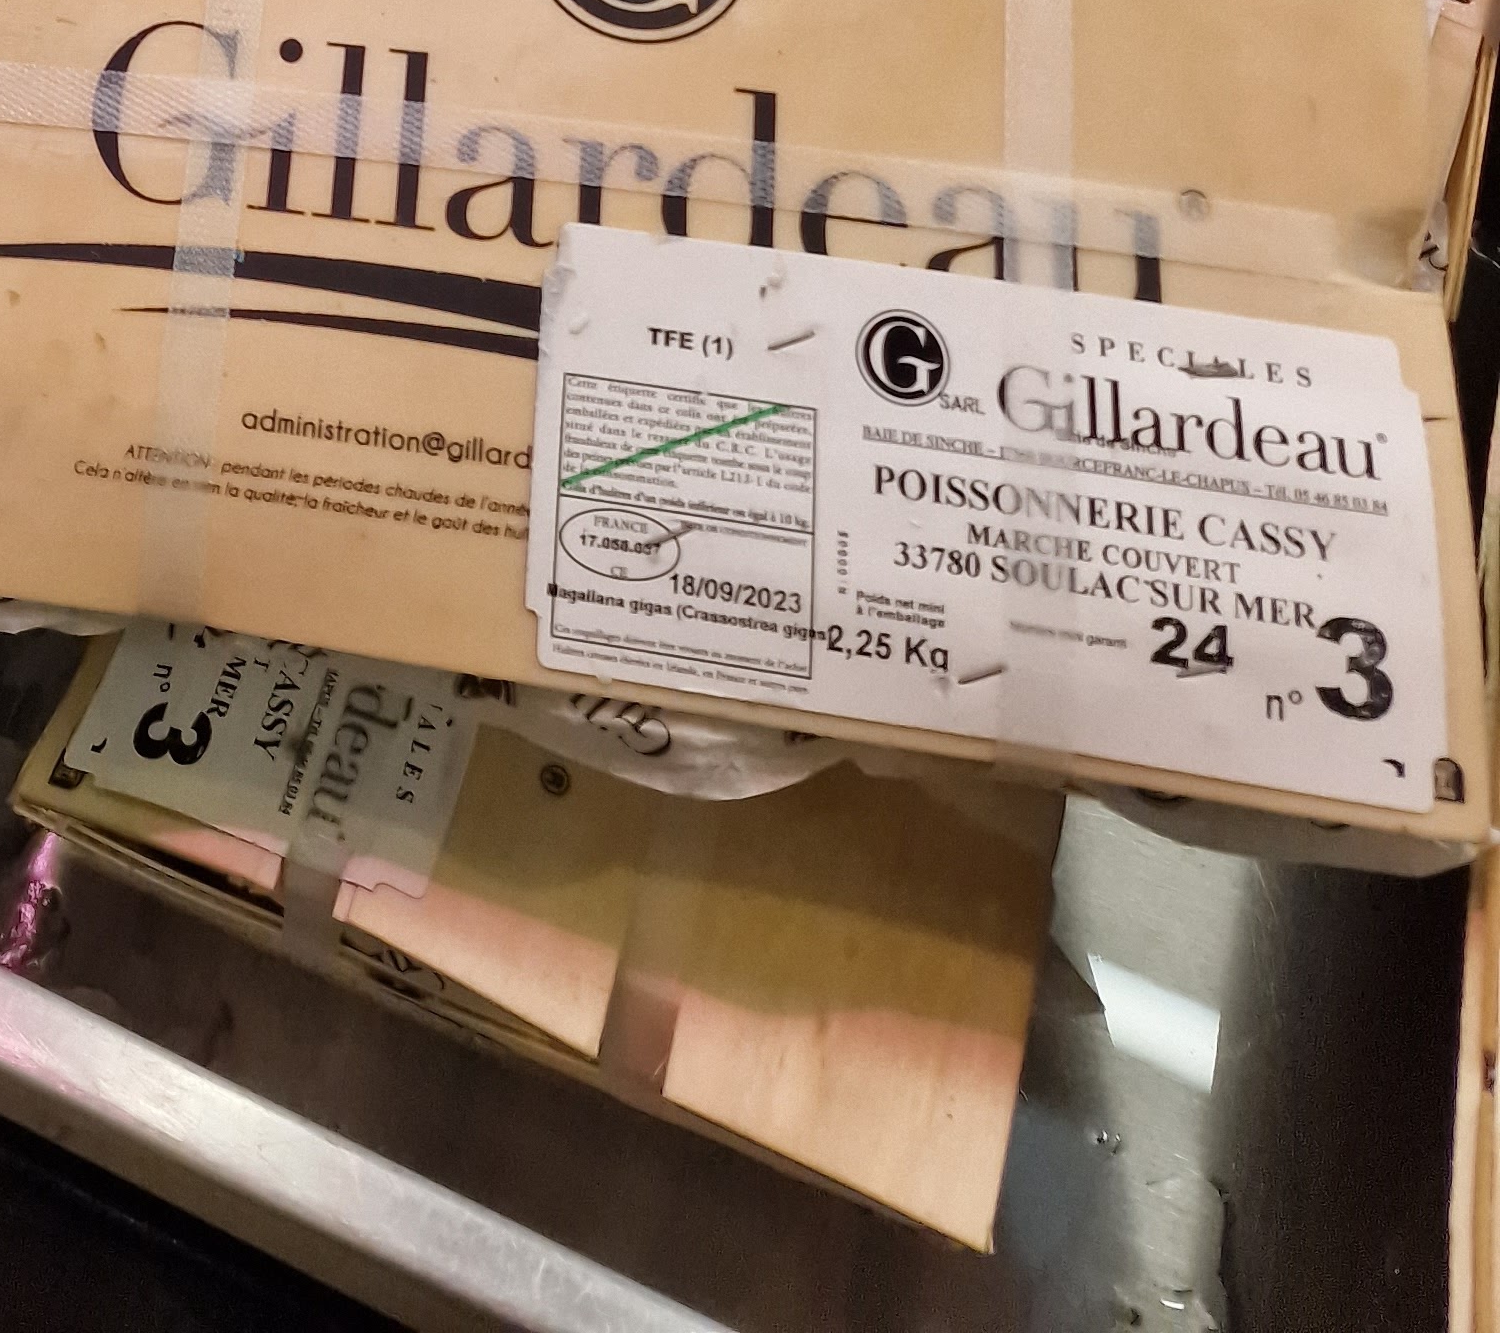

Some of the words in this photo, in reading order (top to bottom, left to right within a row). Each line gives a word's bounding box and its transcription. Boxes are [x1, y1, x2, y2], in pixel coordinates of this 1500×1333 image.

[647, 325, 694, 351] TFE
[702, 333, 734, 360] (1)
[938, 394, 987, 416] SARL
[997, 364, 1384, 481] Gillardeau
[899, 429, 921, 446] DE
[73, 459, 110, 479] Cela
[225, 482, 239, 498] la
[303, 494, 318, 510] la
[322, 496, 389, 520] fraîcheur
[392, 507, 411, 523] et
[412, 510, 428, 526] le
[431, 511, 468, 531] goût
[471, 518, 500, 538] des
[220, 459, 285, 482] pendant
[288, 468, 309, 484] les
[312, 472, 381, 496] périodes
[385, 482, 450, 506] chaudes
[455, 493, 475, 510] de
[593, 515, 649, 535] FRANCE
[873, 464, 1184, 541] POISSONNERIE
[1197, 514, 1337, 563] CASSY
[967, 523, 1093, 563] MARCHE
[1102, 545, 1240, 585] COUVERT
[669, 572, 803, 615] 18/09/2023
[893, 541, 982, 580] 33780
[990, 553, 1143, 605] SOULAC
[1149, 579, 1222, 617] SUR
[1235, 593, 1318, 631] MER
[895, 598, 914, 609] net
[629, 597, 672, 617] gigas
[676, 602, 778, 633] (Crassostrea
[826, 624, 893, 660] 2,25
[1150, 616, 1234, 668] 24
[206, 656, 247, 719] MER
[1314, 616, 1395, 721] 3
[133, 700, 213, 766] 3
